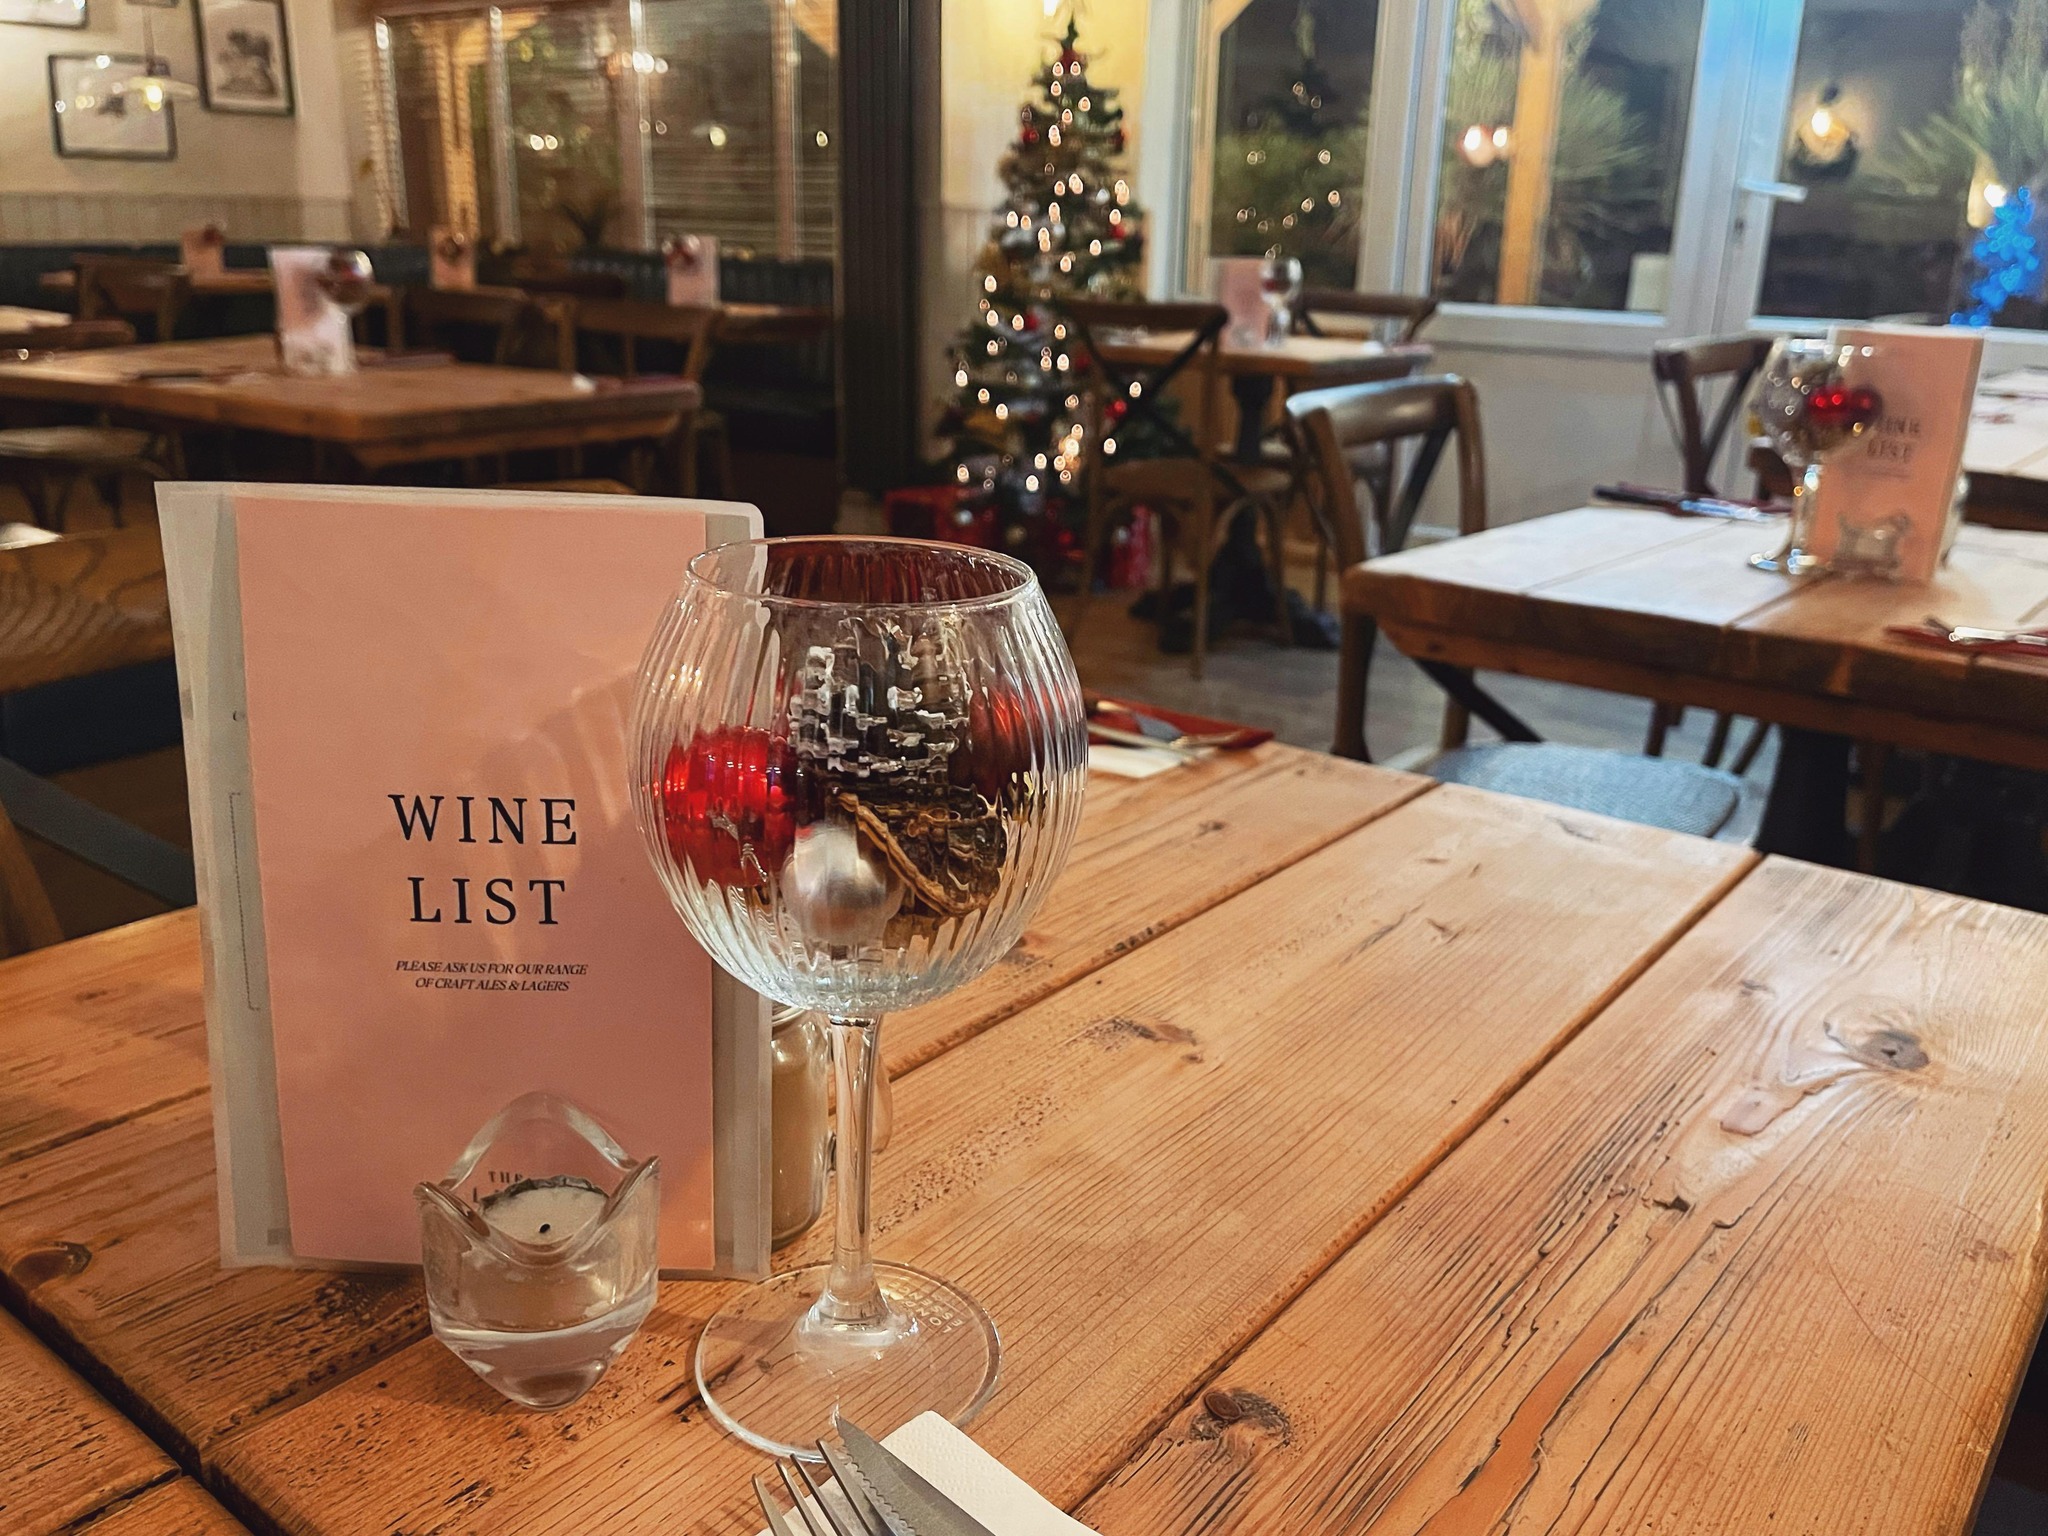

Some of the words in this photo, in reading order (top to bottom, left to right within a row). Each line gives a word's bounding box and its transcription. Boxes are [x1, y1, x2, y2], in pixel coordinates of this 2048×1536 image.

[388, 794, 577, 845] WINE
[408, 877, 565, 924] LIST
[396, 960, 442, 972] PLEASE
[443, 962, 468, 973] ASK
[469, 962, 487, 973] US
[487, 963, 514, 974] FOR
[515, 963, 544, 975] OUR
[545, 963, 589, 975] RANGE
[415, 977, 434, 988] OF
[434, 978, 476, 990] CRAFT
[474, 979, 507, 991] ALES
[508, 980, 520, 991] &
[521, 980, 571, 992] LAGERS
